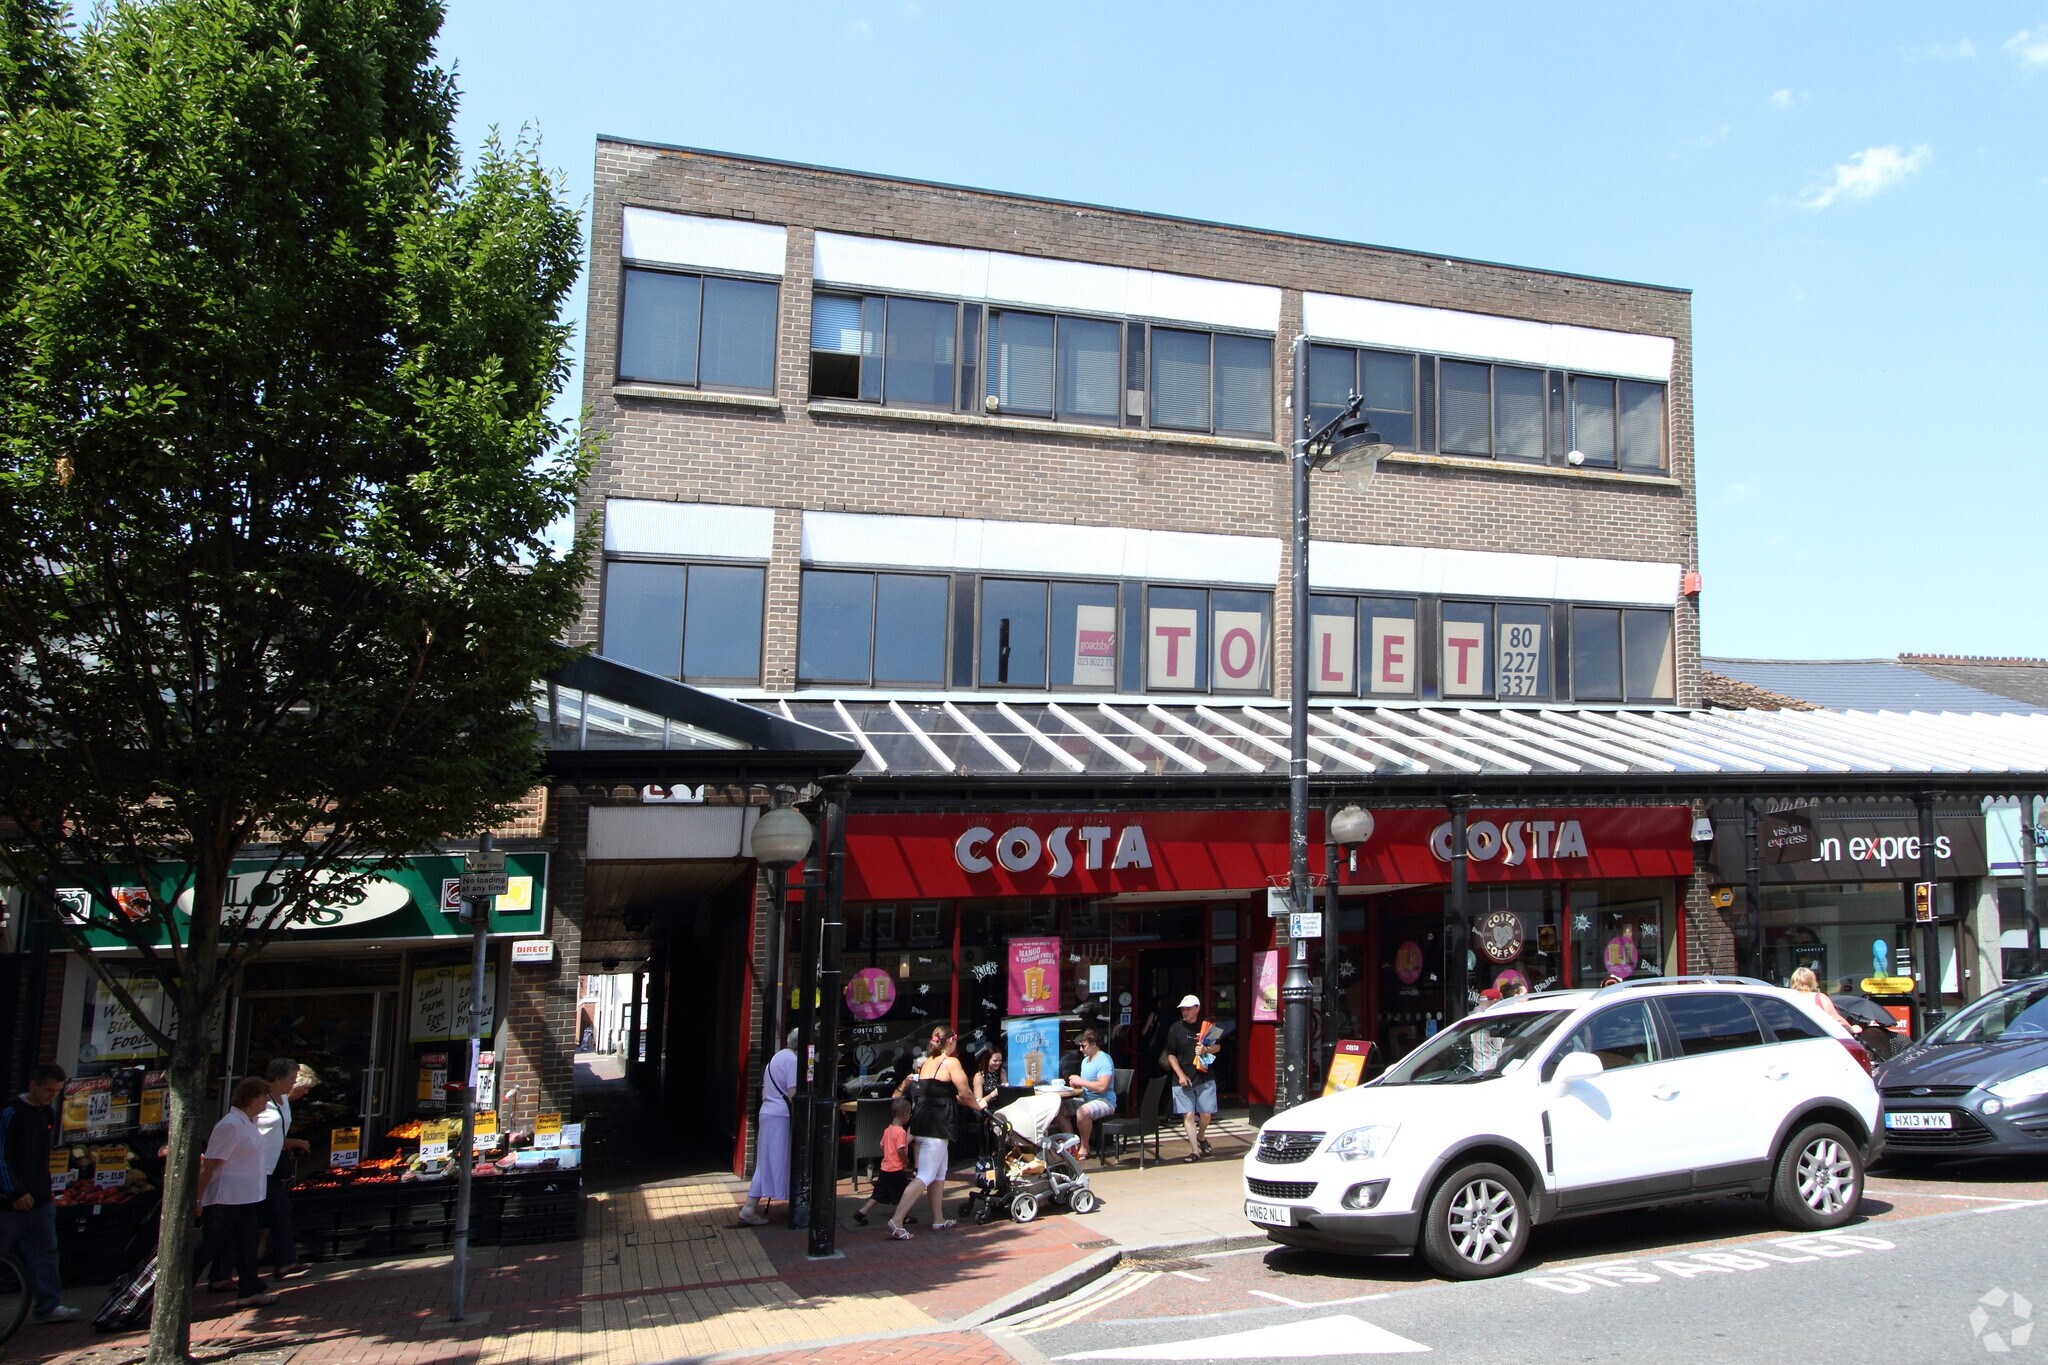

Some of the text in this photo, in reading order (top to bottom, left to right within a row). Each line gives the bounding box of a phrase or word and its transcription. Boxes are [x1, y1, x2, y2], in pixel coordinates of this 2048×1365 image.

[1080, 636, 1110, 652] goadsby
[1510, 627, 1532, 648] 80
[1078, 658, 1089, 666] 023
[1090, 658, 1104, 667] 8022
[1156, 626, 1479, 684] TO LET
[1502, 652, 1537, 674] 227
[1502, 676, 1536, 696] 337
[1772, 824, 1802, 837] vision
[1430, 821, 1588, 866] COSTA
[1767, 833, 1808, 848] express
[955, 827, 1152, 878] COSTA
[1849, 836, 1951, 867] expres
[476, 876, 506, 885] loading
[1294, 916, 1300, 924] P
[1488, 912, 1516, 928] COSTA
[1018, 946, 1041, 957] MANGO
[1486, 940, 1520, 958] COFFEE
[1020, 954, 1040, 963] PASSION
[1038, 958, 1056, 966] COOLER
[975, 962, 996, 978] KICK
[419, 981, 444, 1002] Local
[421, 998, 444, 1014] Farm
[426, 1012, 445, 1032] Eggs
[1016, 1030, 1046, 1044] COFFEE
[480, 1076, 492, 1092] 79p
[1895, 1116, 1946, 1126] HX13 WYK
[332, 1153, 339, 1161] 2
[97, 1172, 104, 1180] 5
[1250, 1206, 1286, 1222] HN62 NLL
[1524, 1231, 1897, 1294] DISABLED
